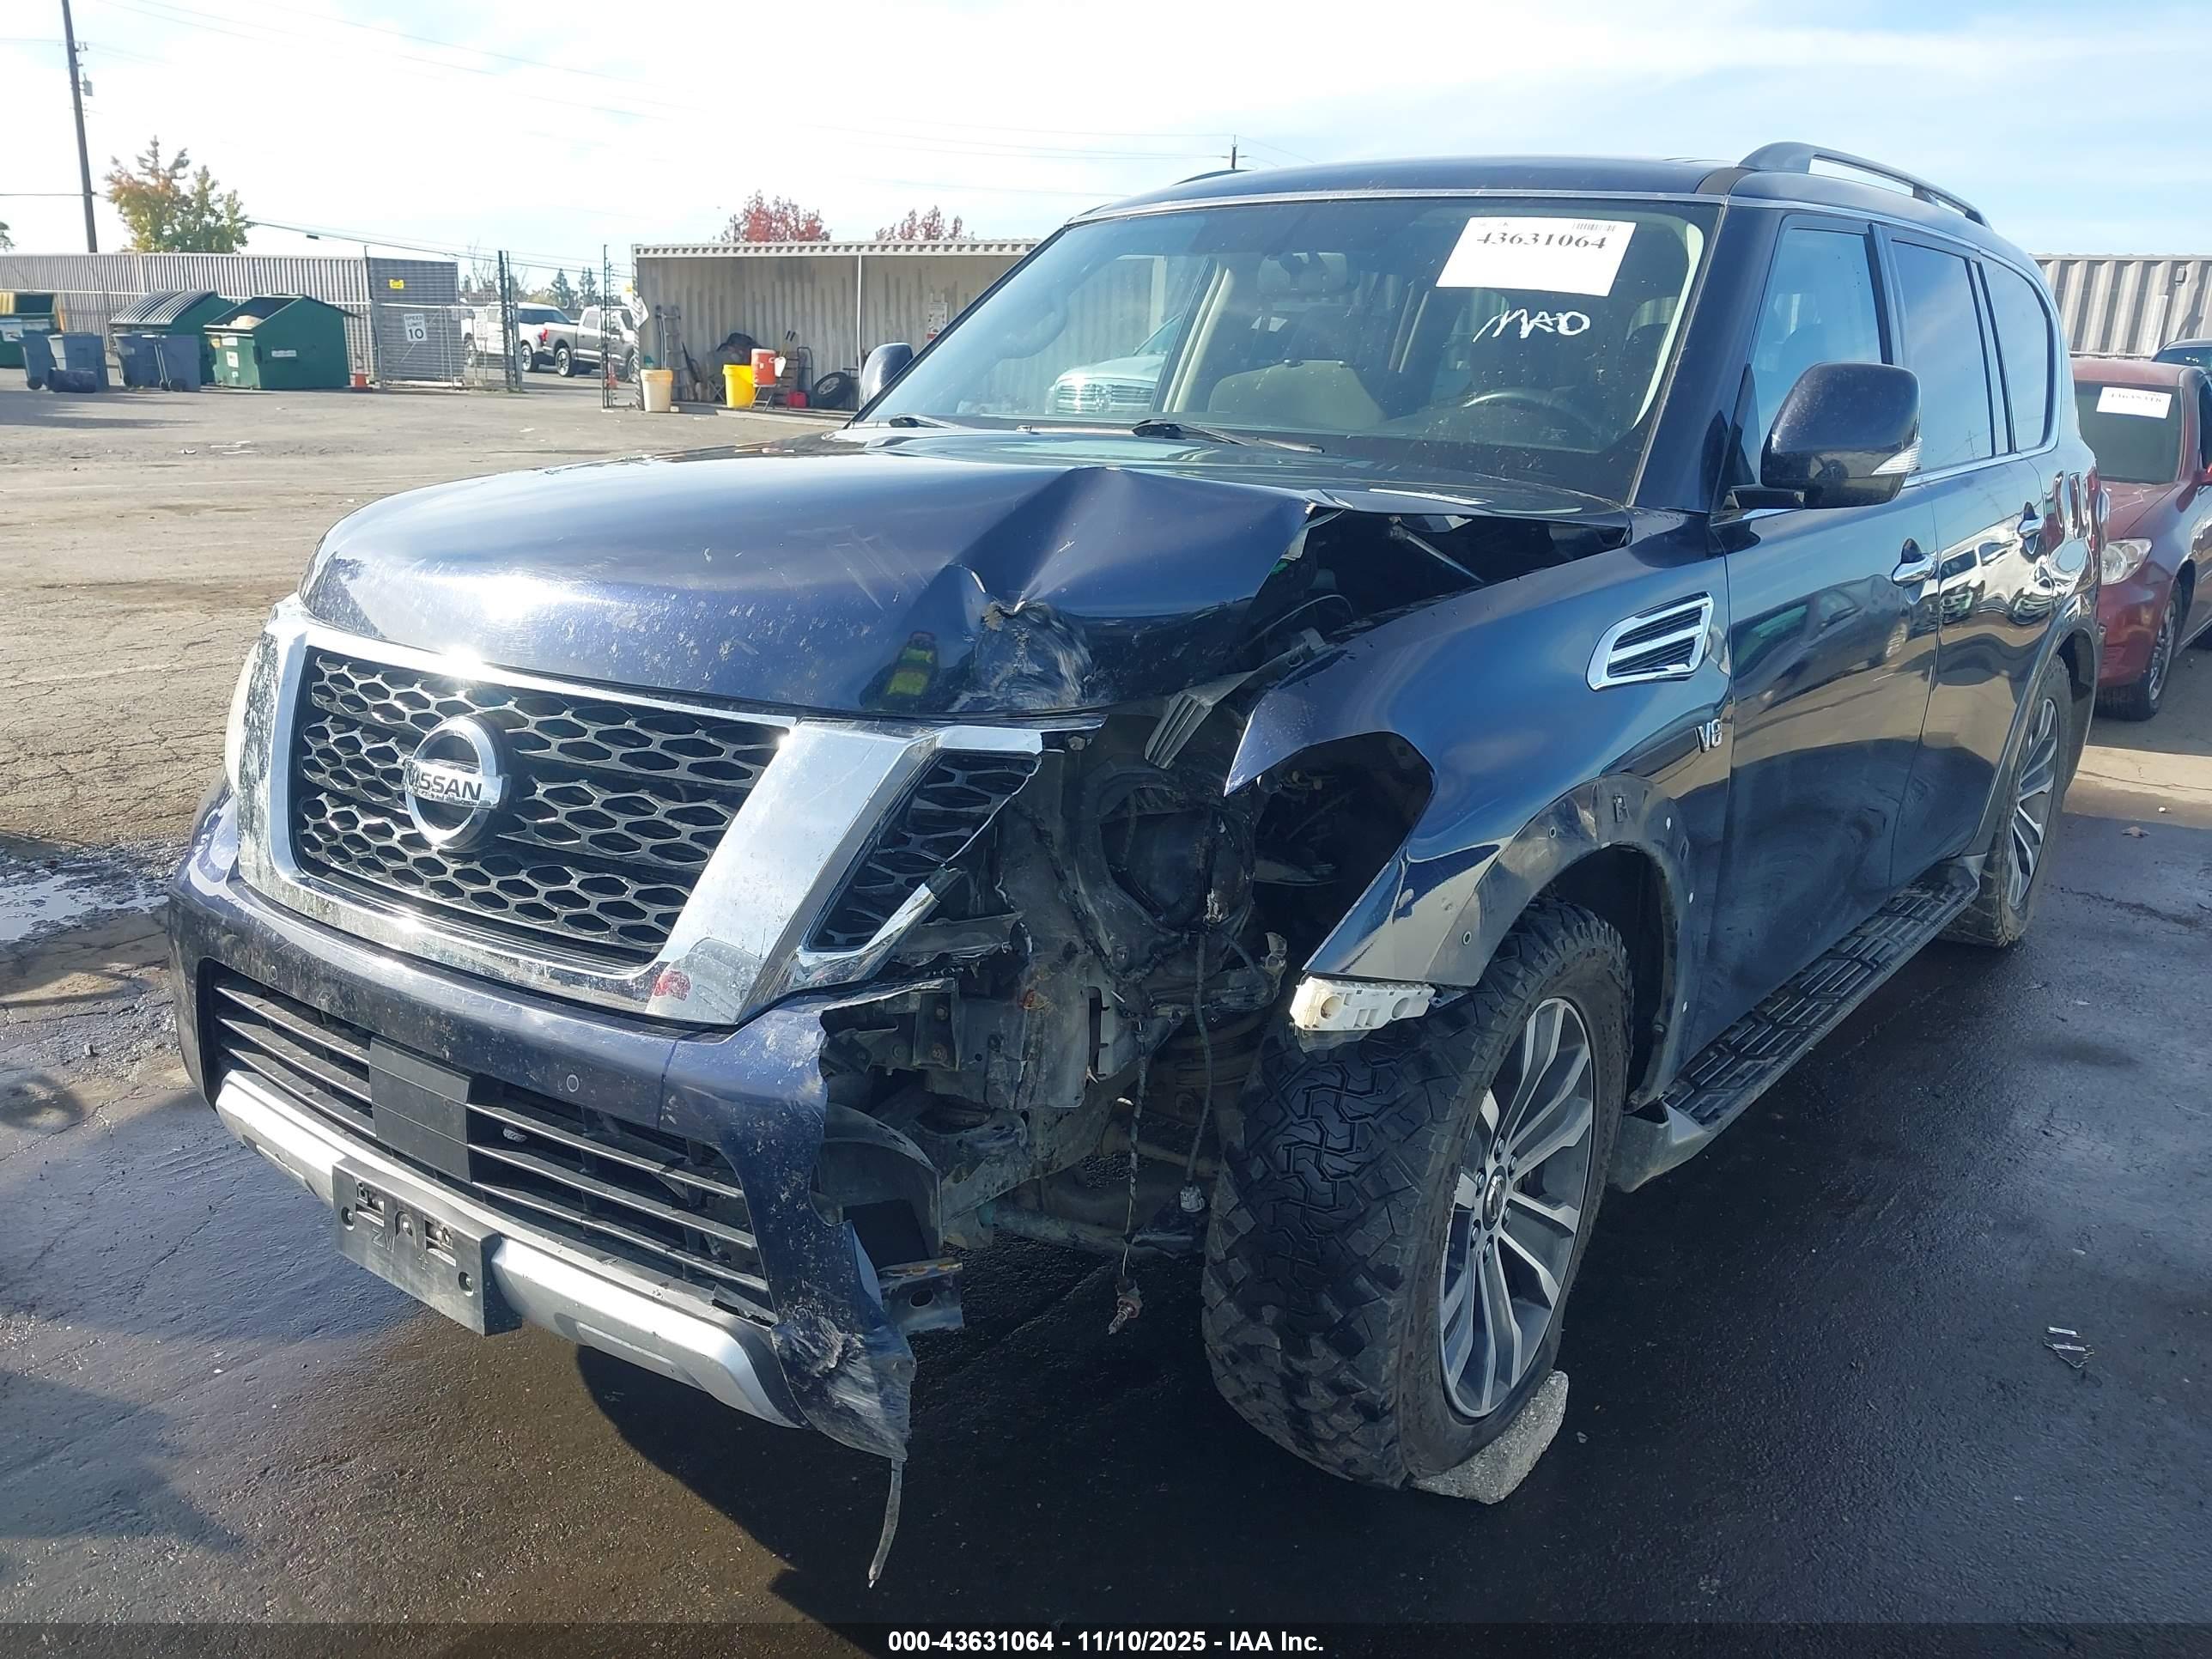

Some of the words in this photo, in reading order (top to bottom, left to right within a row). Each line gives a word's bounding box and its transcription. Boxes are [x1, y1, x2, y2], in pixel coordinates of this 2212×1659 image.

[1477, 232, 1607, 249] 43631064
[408, 328, 424, 340] 10
[1694, 719, 1723, 753] V8
[405, 763, 483, 801] NISSAN
